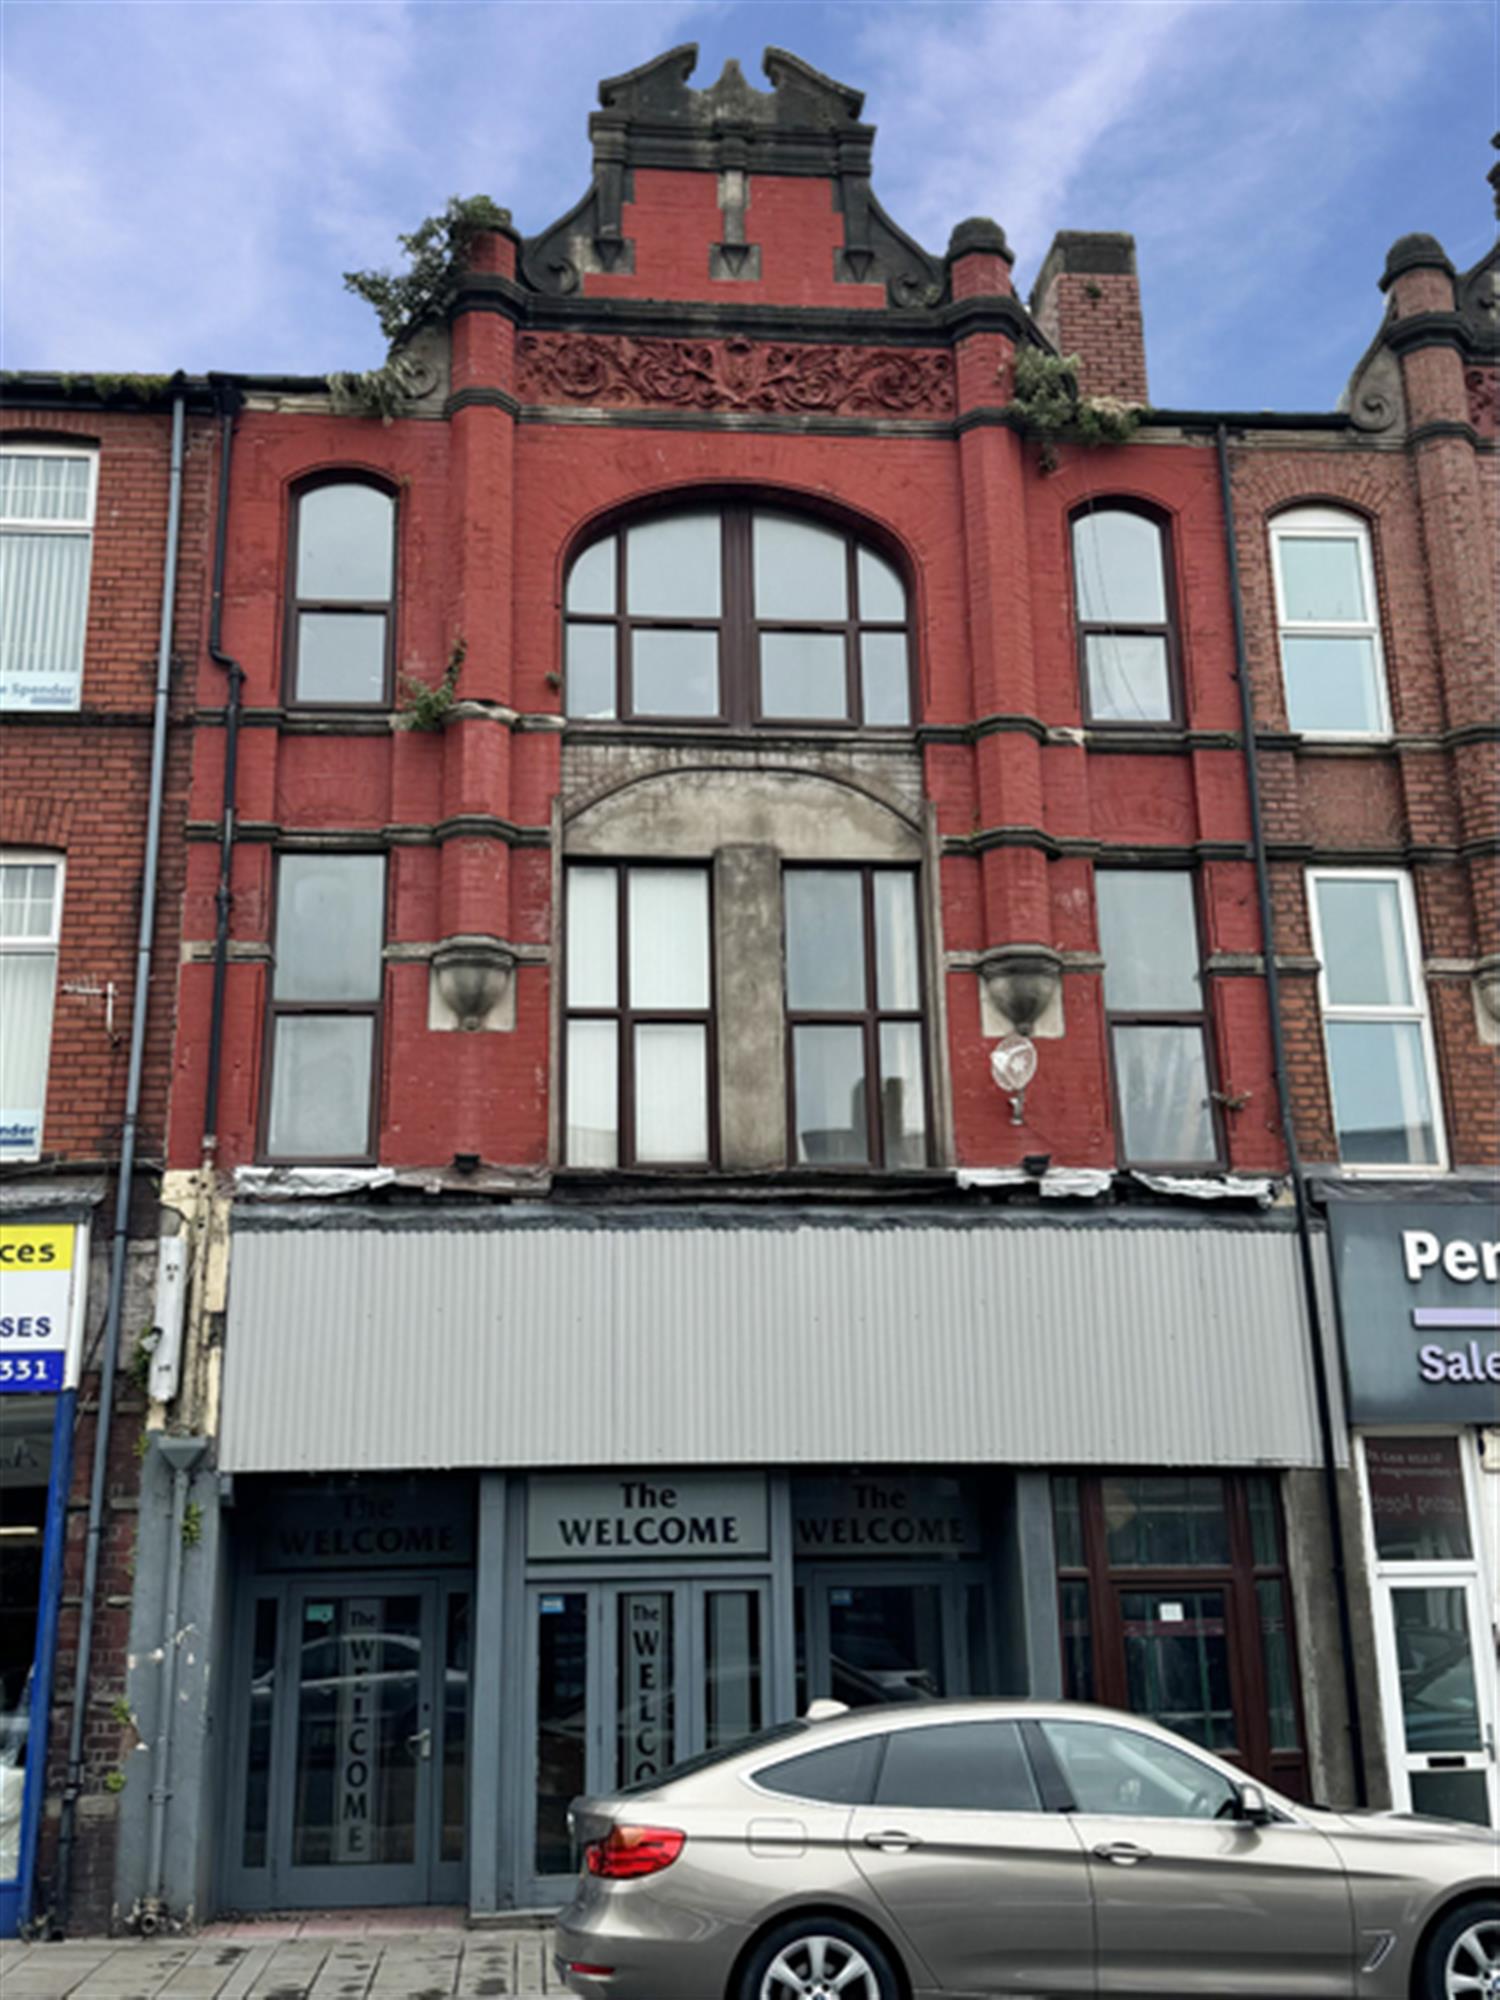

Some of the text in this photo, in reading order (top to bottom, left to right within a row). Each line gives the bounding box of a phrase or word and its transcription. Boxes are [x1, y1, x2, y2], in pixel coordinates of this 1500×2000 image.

[0, 1242, 56, 1263] ces
[0, 1316, 51, 1338] SES
[0, 1359, 47, 1381] 331
[341, 1493, 395, 1520] The
[620, 1482, 677, 1509] The
[854, 1484, 907, 1510] The
[278, 1525, 454, 1556] WELCOME
[558, 1516, 739, 1546] WELCOME
[798, 1517, 965, 1544] WELCOME
[351, 1611, 376, 1627] The
[633, 1604, 659, 1622] The
[343, 1639, 375, 1853] WELCOME
